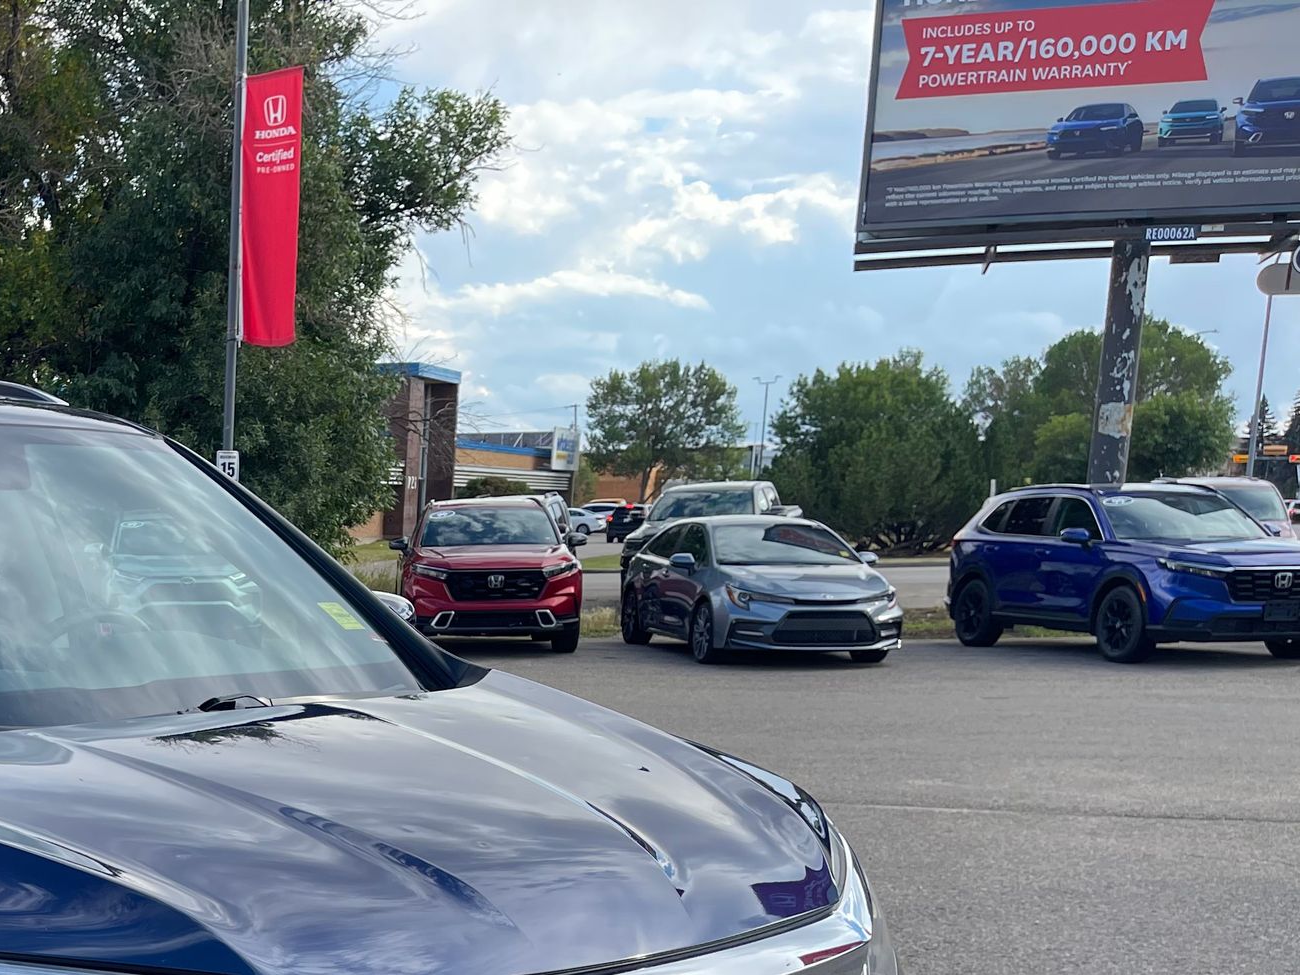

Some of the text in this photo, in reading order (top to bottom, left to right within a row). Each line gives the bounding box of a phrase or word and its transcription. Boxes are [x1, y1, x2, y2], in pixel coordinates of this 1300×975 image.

[922, 20, 1035, 39] INCLUDES UP TO
[920, 29, 1188, 67] 7-YEAR/160,000 KM
[919, 68, 1026, 88] POWERTRAIN
[254, 126, 297, 139] HONDA
[256, 146, 294, 164] Certified
[256, 163, 295, 174] PRE-OWNED
[1145, 227, 1195, 240] RE00062A
[220, 461, 236, 477] 15
